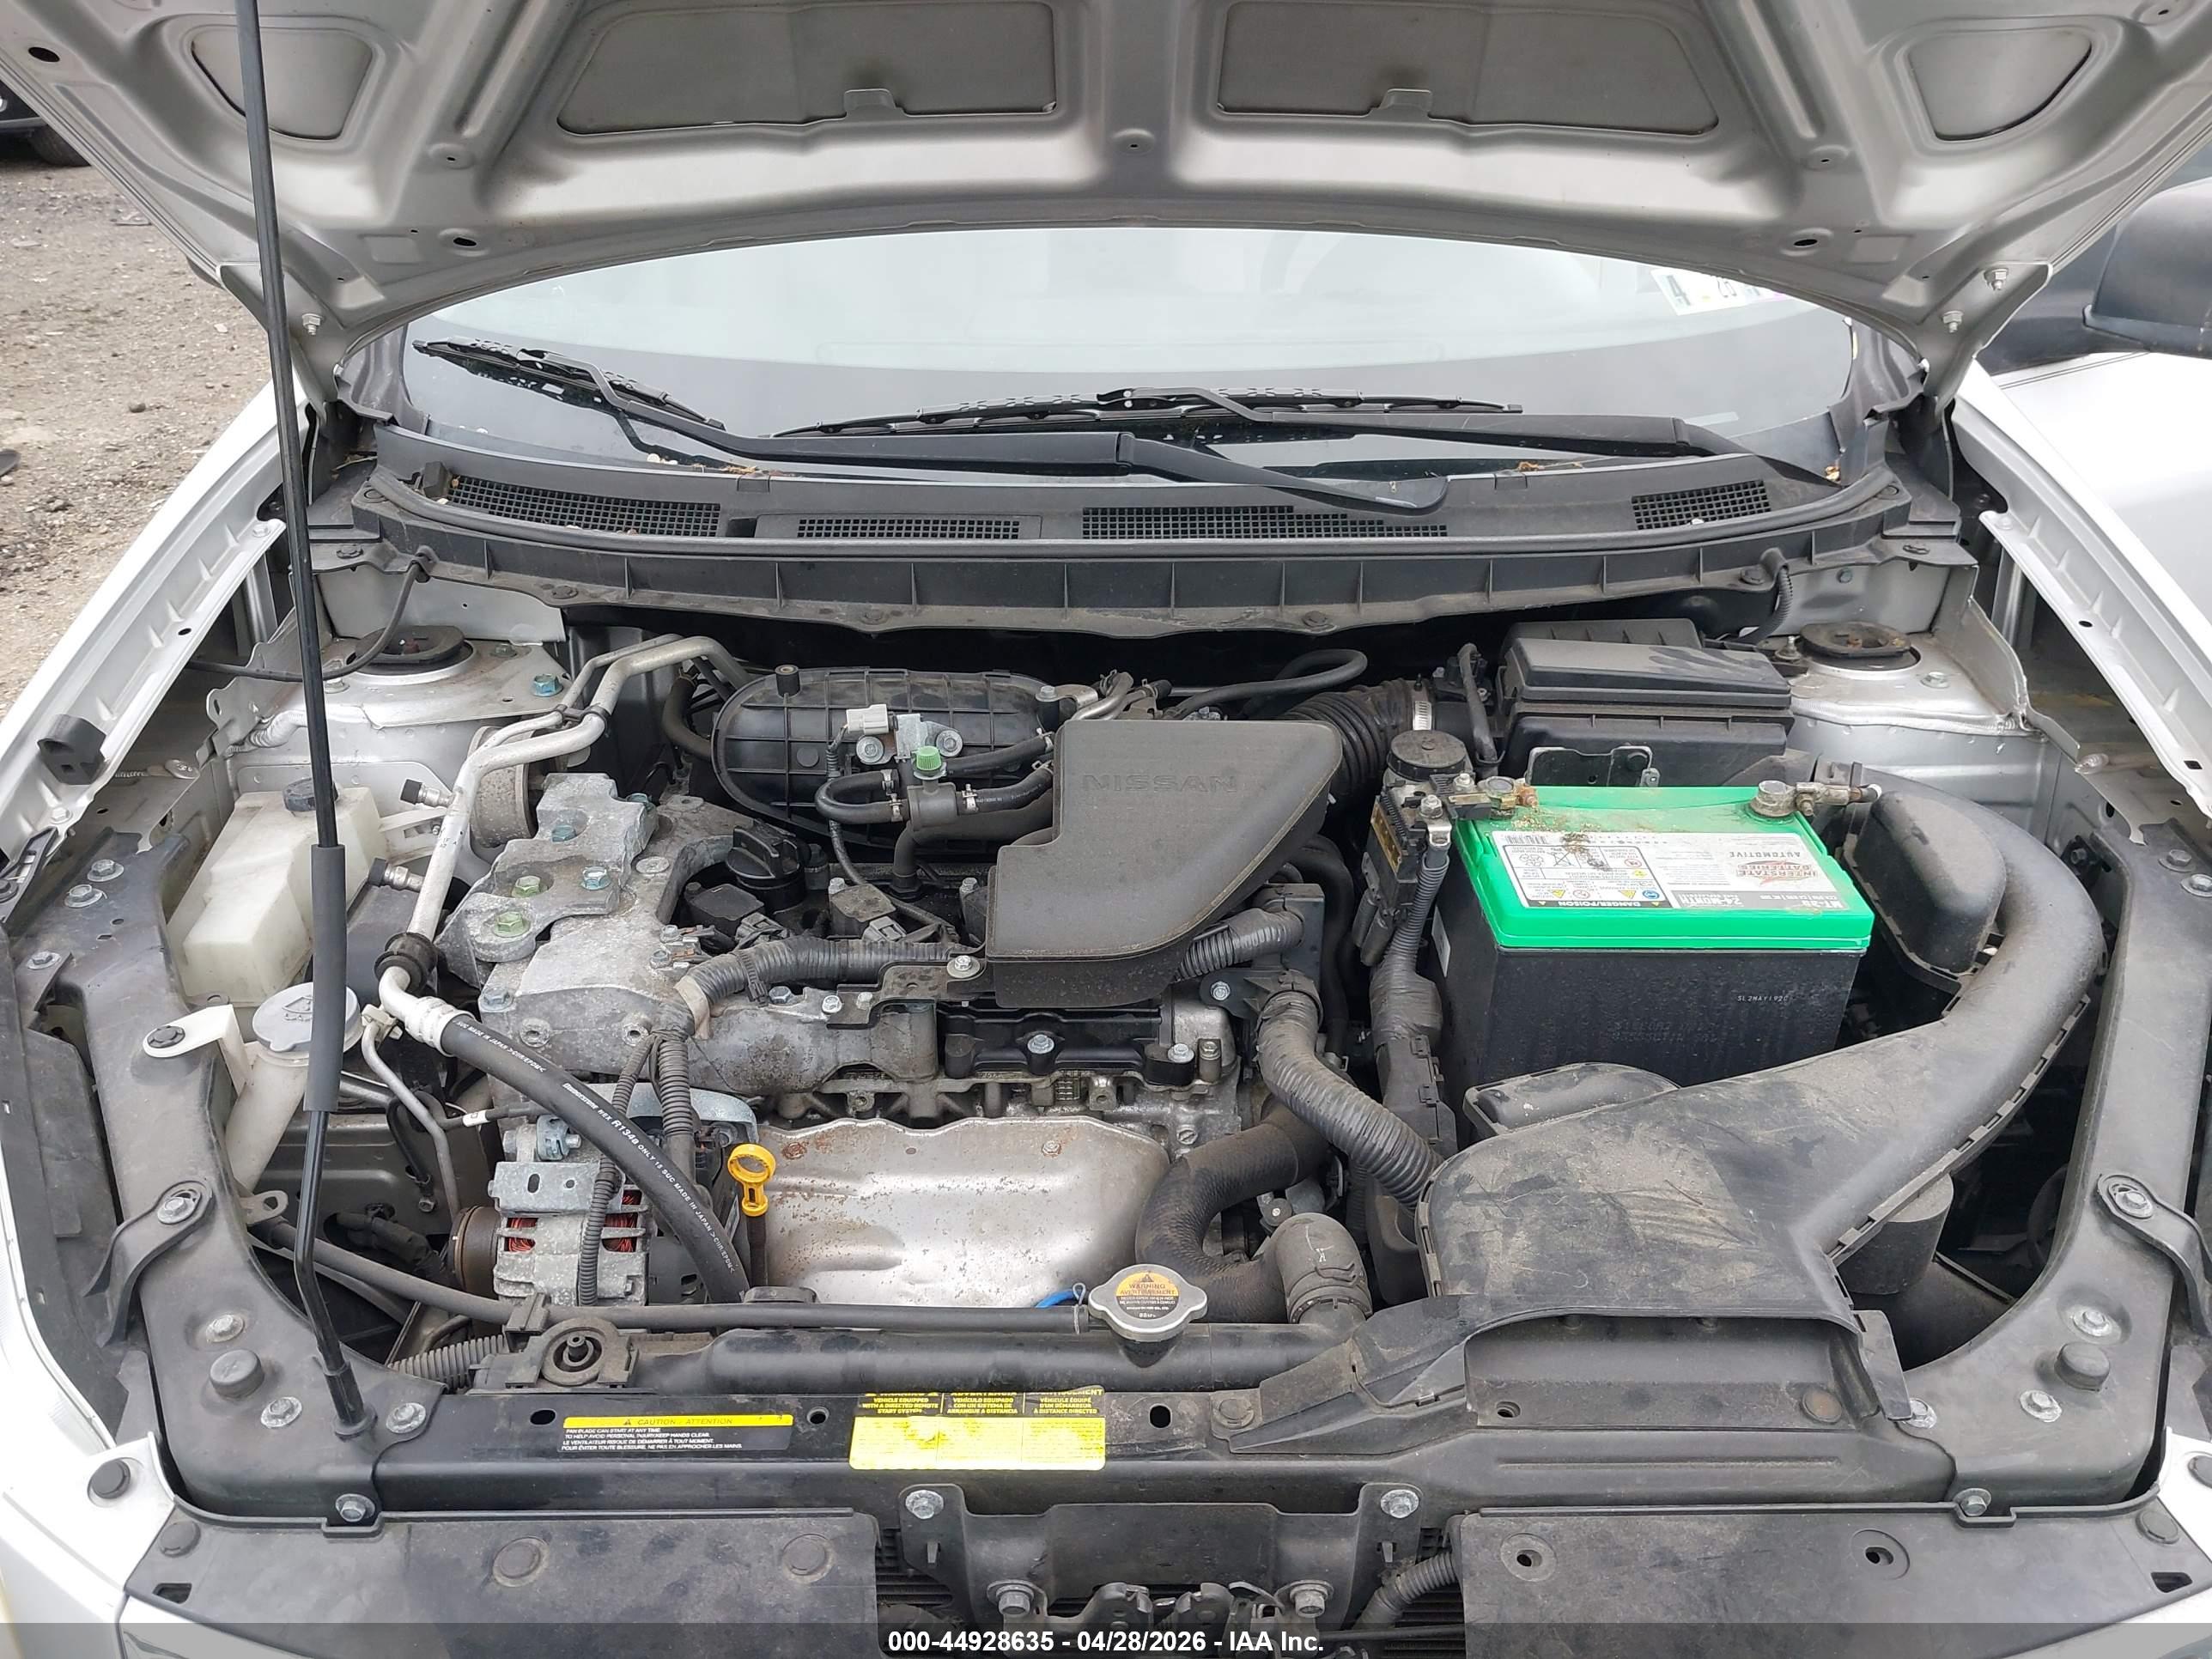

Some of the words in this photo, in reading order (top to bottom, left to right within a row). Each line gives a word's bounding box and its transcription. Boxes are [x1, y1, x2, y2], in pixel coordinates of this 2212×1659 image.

[1083, 775, 1237, 793] NISSAN
[468, 1026, 484, 1036] MADE
[489, 1037, 507, 1050] JAPAN
[611, 1119, 640, 1146] R134a
[637, 1144, 656, 1161] ONLY
[673, 1182, 691, 1203] MADE
[695, 1210, 713, 1232] JAPAN
